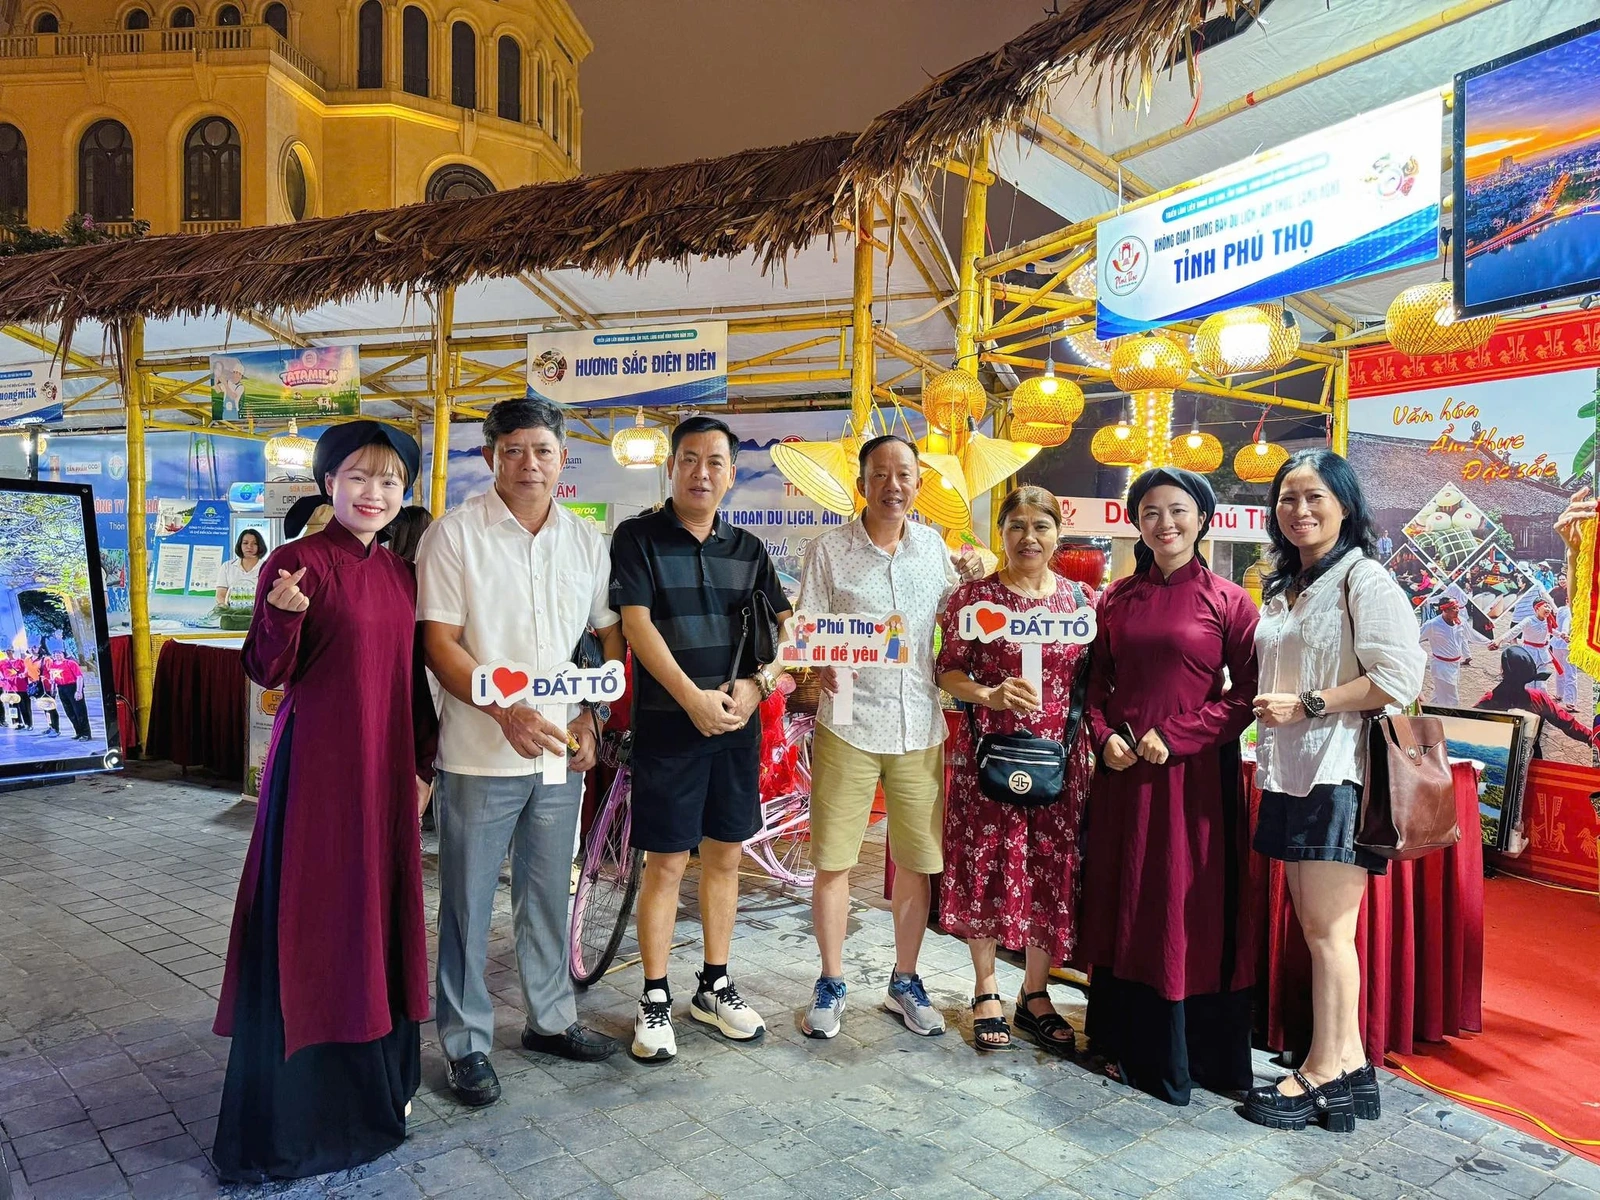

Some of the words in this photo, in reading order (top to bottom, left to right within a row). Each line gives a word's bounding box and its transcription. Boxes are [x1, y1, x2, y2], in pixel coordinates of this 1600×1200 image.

[1154, 233, 1175, 254] KHÔNG
[1175, 230, 1191, 246] GIAN
[1173, 247, 1217, 284] TỈNH
[1223, 229, 1264, 270] PHÚ
[1272, 219, 1314, 254] THỌ
[575, 356, 618, 377] HƯƠNG
[622, 350, 648, 374] SẮC
[651, 349, 682, 377] ĐIỆN
[686, 348, 717, 372] BIÊN
[280, 369, 338, 385] TATAMILK
[1393, 406, 1434, 426] Văn
[1440, 397, 1480, 421] hóa
[1429, 423, 1467, 455] Ẩm
[1472, 427, 1525, 456] thực
[1461, 458, 1511, 484] Đặc
[1516, 454, 1558, 479] sắc
[553, 482, 576, 498] ÃM
[95, 496, 112, 513] ÔNG
[733, 510, 763, 525] HOAN
[767, 510, 783, 525] DU
[787, 510, 818, 528] LỊCH,
[1211, 507, 1237, 528] hú
[816, 618, 844, 635] Phú
[848, 618, 874, 638] Thọ
[1009, 613, 1055, 636] ĐẤT
[1059, 614, 1090, 637] TỔ
[812, 645, 826, 661] đi
[830, 641, 849, 662] để
[852, 645, 878, 664] yêu
[532, 669, 583, 697] ĐẤT
[587, 667, 618, 694] TỔ
